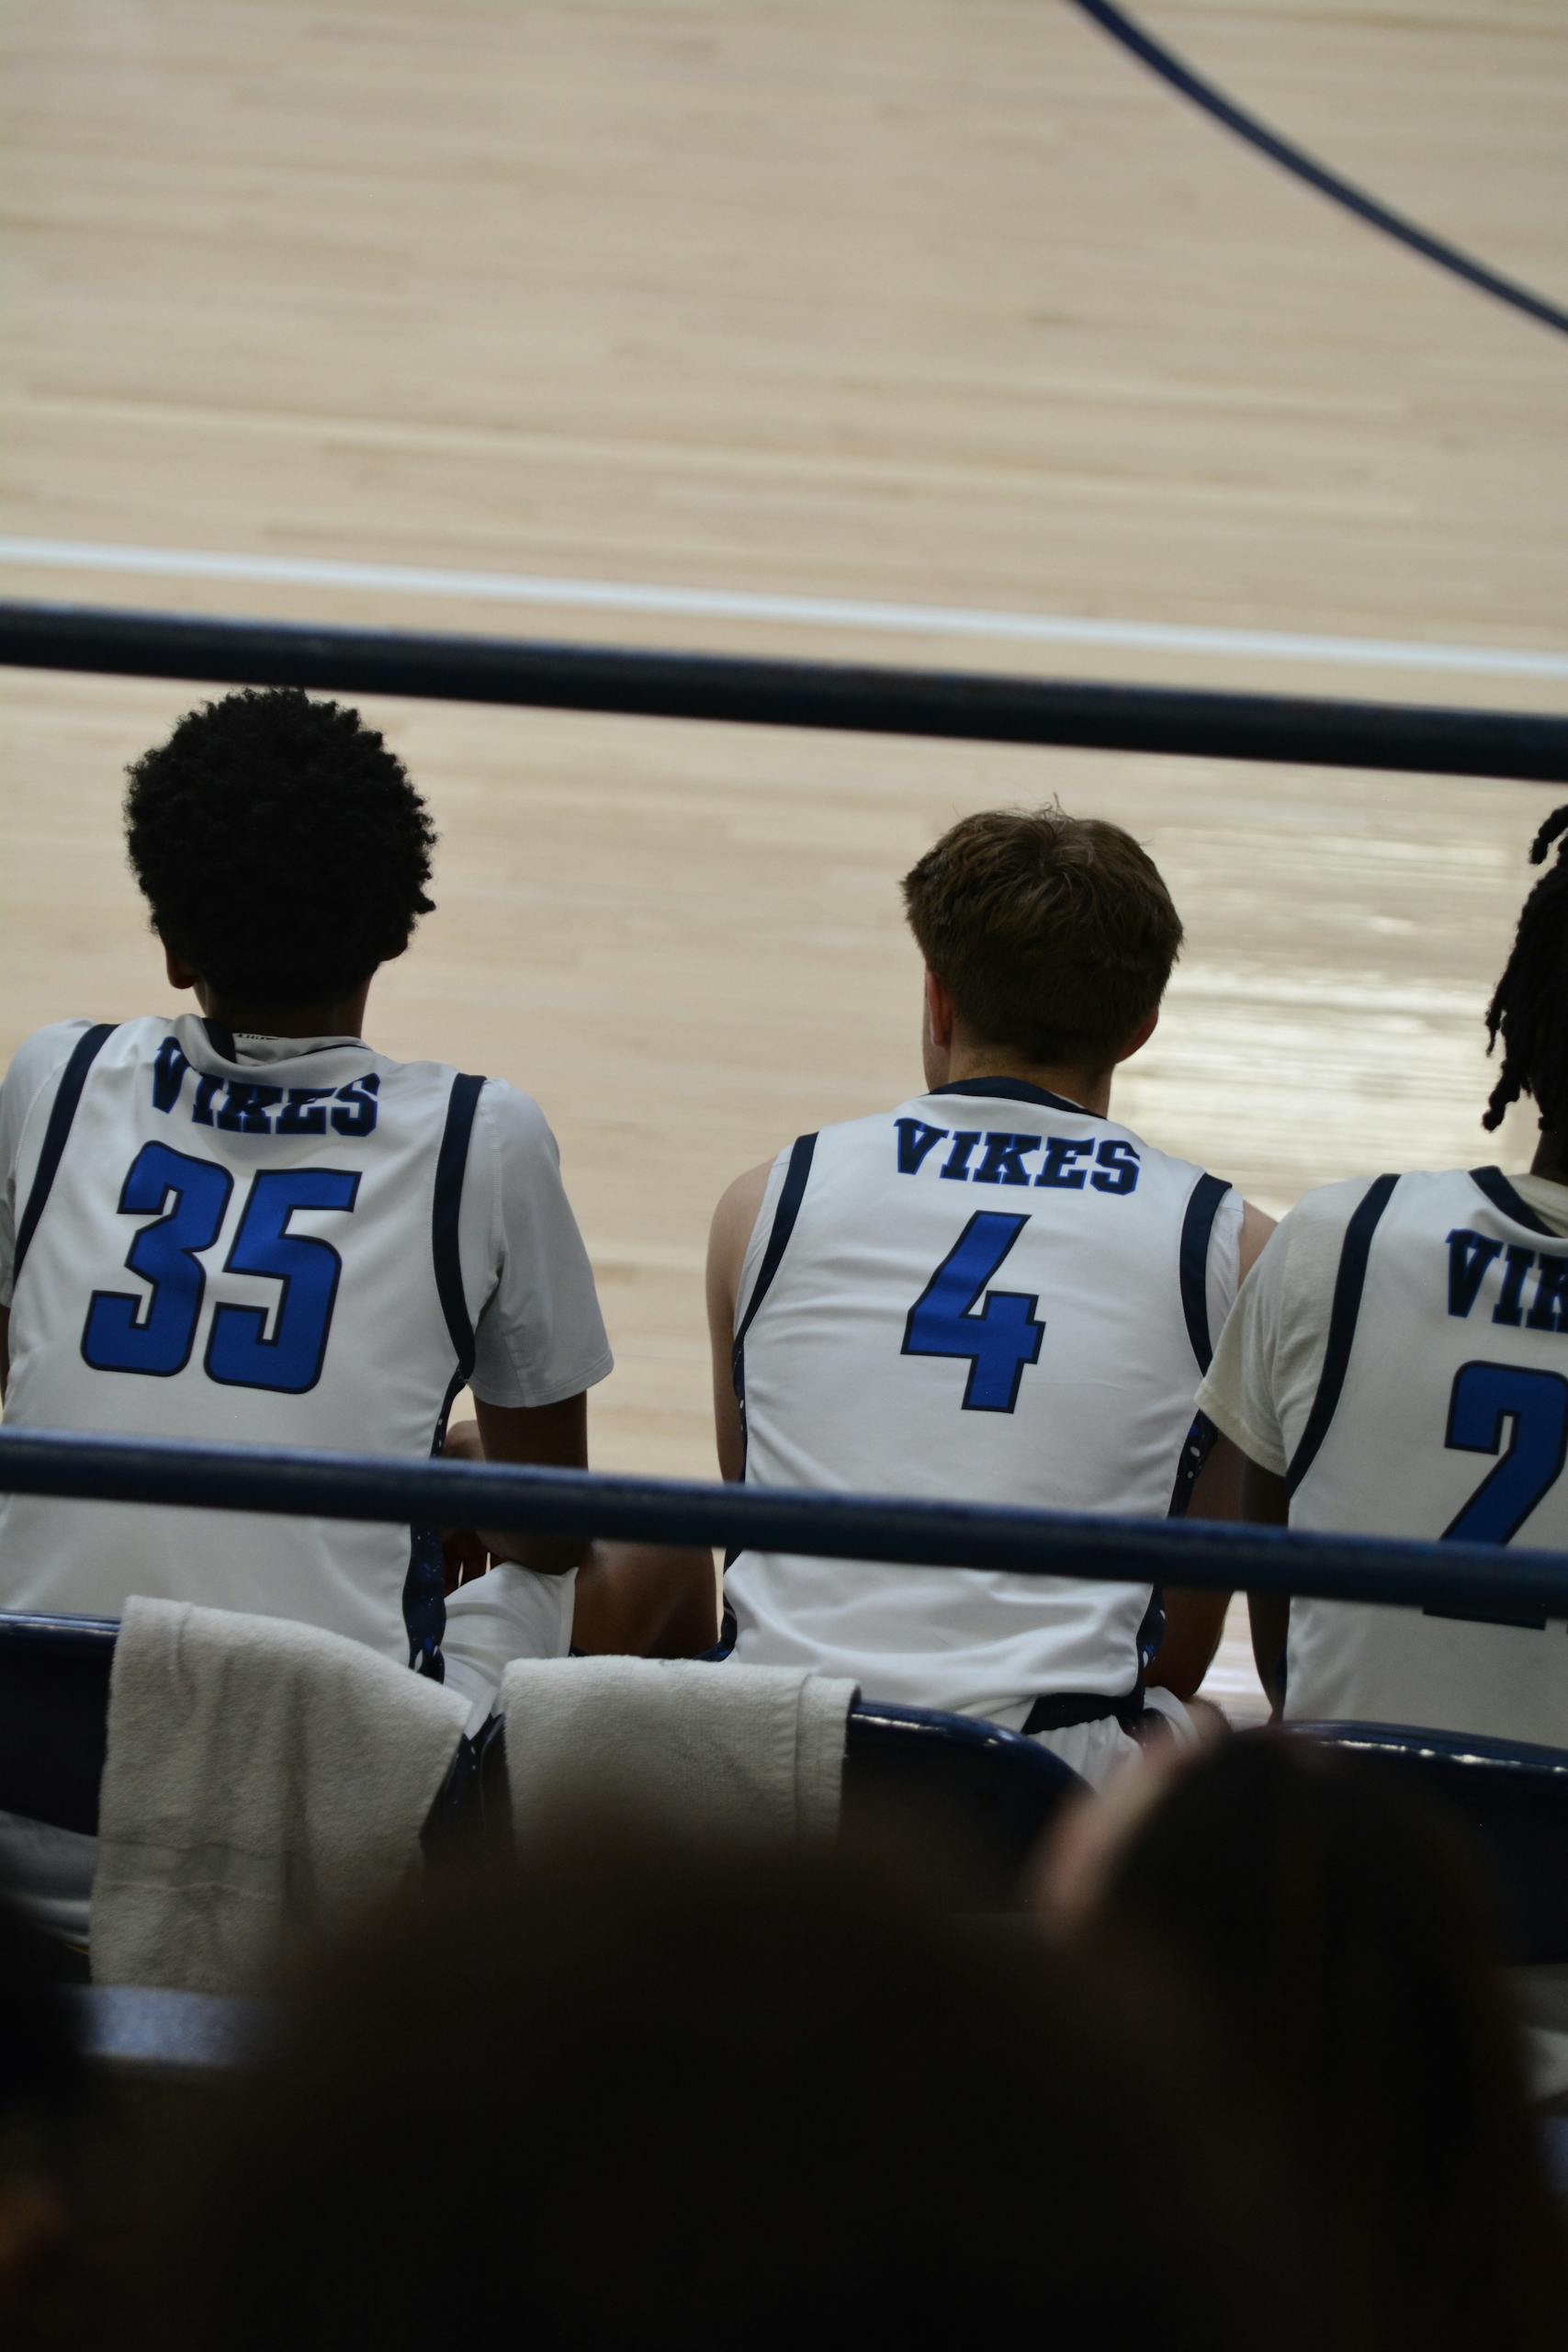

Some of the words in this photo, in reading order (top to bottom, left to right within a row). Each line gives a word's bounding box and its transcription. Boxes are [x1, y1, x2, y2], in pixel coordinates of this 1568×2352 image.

[152, 1036, 380, 1136] VIKES
[893, 1117, 1140, 1195] VIKES
[81, 1140, 363, 1395] 35
[900, 1210, 1046, 1414] 4
